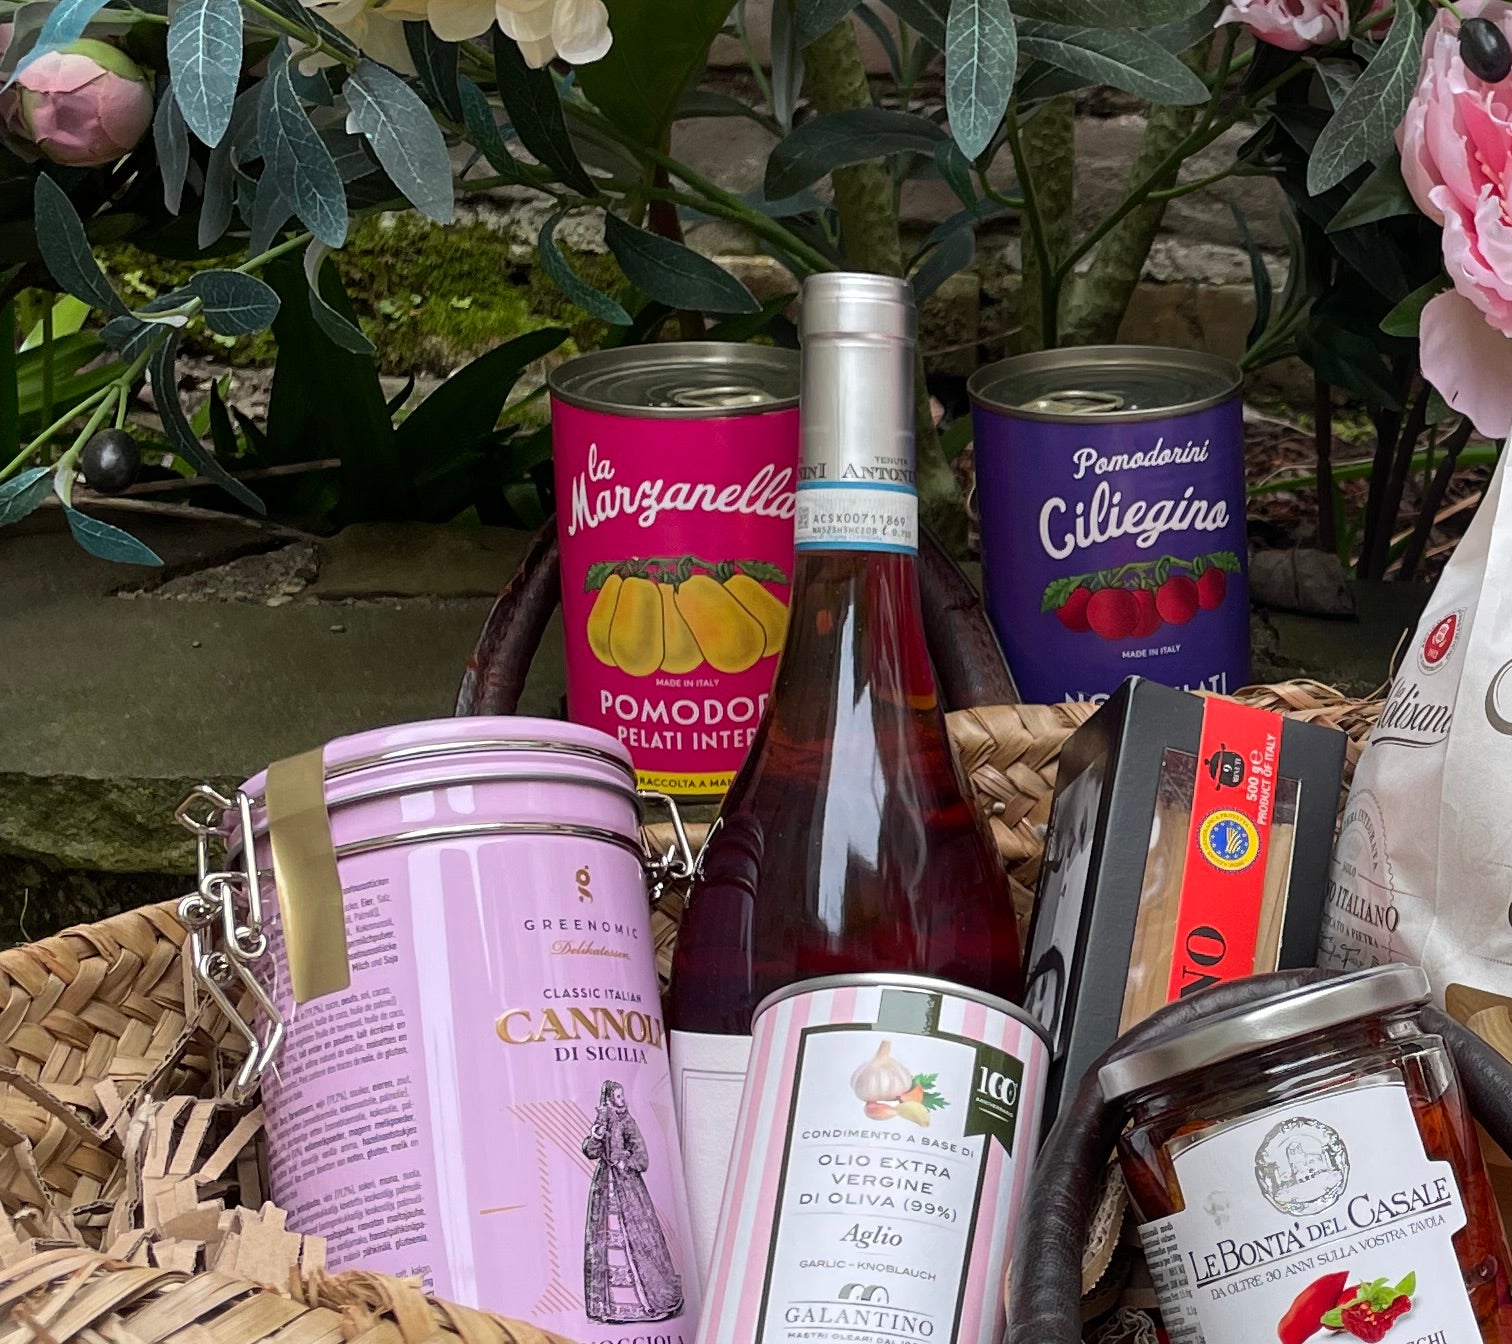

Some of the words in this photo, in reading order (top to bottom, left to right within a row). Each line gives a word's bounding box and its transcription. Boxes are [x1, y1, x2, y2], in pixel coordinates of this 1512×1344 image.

[588, 443, 615, 482] la
[1073, 437, 1210, 480] Pomodorini
[568, 463, 799, 536] Marzanella
[1039, 480, 1230, 560] Ciliegino
[1122, 649, 1147, 659] MADE
[1149, 648, 1159, 657] IN
[1160, 644, 1182, 655] ITALY
[655, 678, 682, 688] MADE
[683, 679, 694, 688] IN
[695, 678, 719, 688] ITALY
[617, 725, 683, 751] PELATI
[1265, 733, 1276, 762] ITALY
[639, 776, 695, 788] RACCOLTA
[698, 780, 707, 788] A
[1264, 763, 1273, 778] OF
[1246, 777, 1259, 801] 500
[1257, 779, 1271, 826] PRODUCT
[524, 919, 639, 940] GREENOMIC
[543, 988, 601, 1000] CLASSIC
[605, 989, 642, 1003] ITALIAN
[554, 1046, 579, 1062] DI
[586, 1046, 648, 1064] SICILIA
[802, 1129, 902, 1142] CONDIMENTO
[906, 1135, 917, 1144] A
[921, 1137, 957, 1153] BASE
[961, 1147, 975, 1159] DI
[818, 1154, 871, 1168] OLIO
[880, 1156, 952, 1180] EXTRA
[831, 1173, 934, 1195] VERGINE
[799, 1193, 820, 1205] DI
[828, 1192, 895, 1208] OLIVA
[903, 1198, 957, 1223] (99%)
[839, 1222, 903, 1249] Aglio
[1188, 1250, 1221, 1282] LE
[1306, 1217, 1347, 1242] DEL
[1347, 1177, 1451, 1229] CASALE
[1210, 1287, 1227, 1300] DA
[1227, 1274, 1265, 1295] OLTRE
[1266, 1268, 1282, 1283] 30
[1285, 1259, 1315, 1277] ANNI
[1317, 1246, 1358, 1266] SULLA
[1359, 1227, 1407, 1251] VOSTRA
[1410, 1214, 1446, 1235] TAVOLA
[799, 1259, 847, 1269] GARLIC
[857, 1262, 937, 1282] KNOBLAUCH
[785, 1306, 934, 1338] GALANTINO
[787, 1331, 828, 1340] MASTRI
